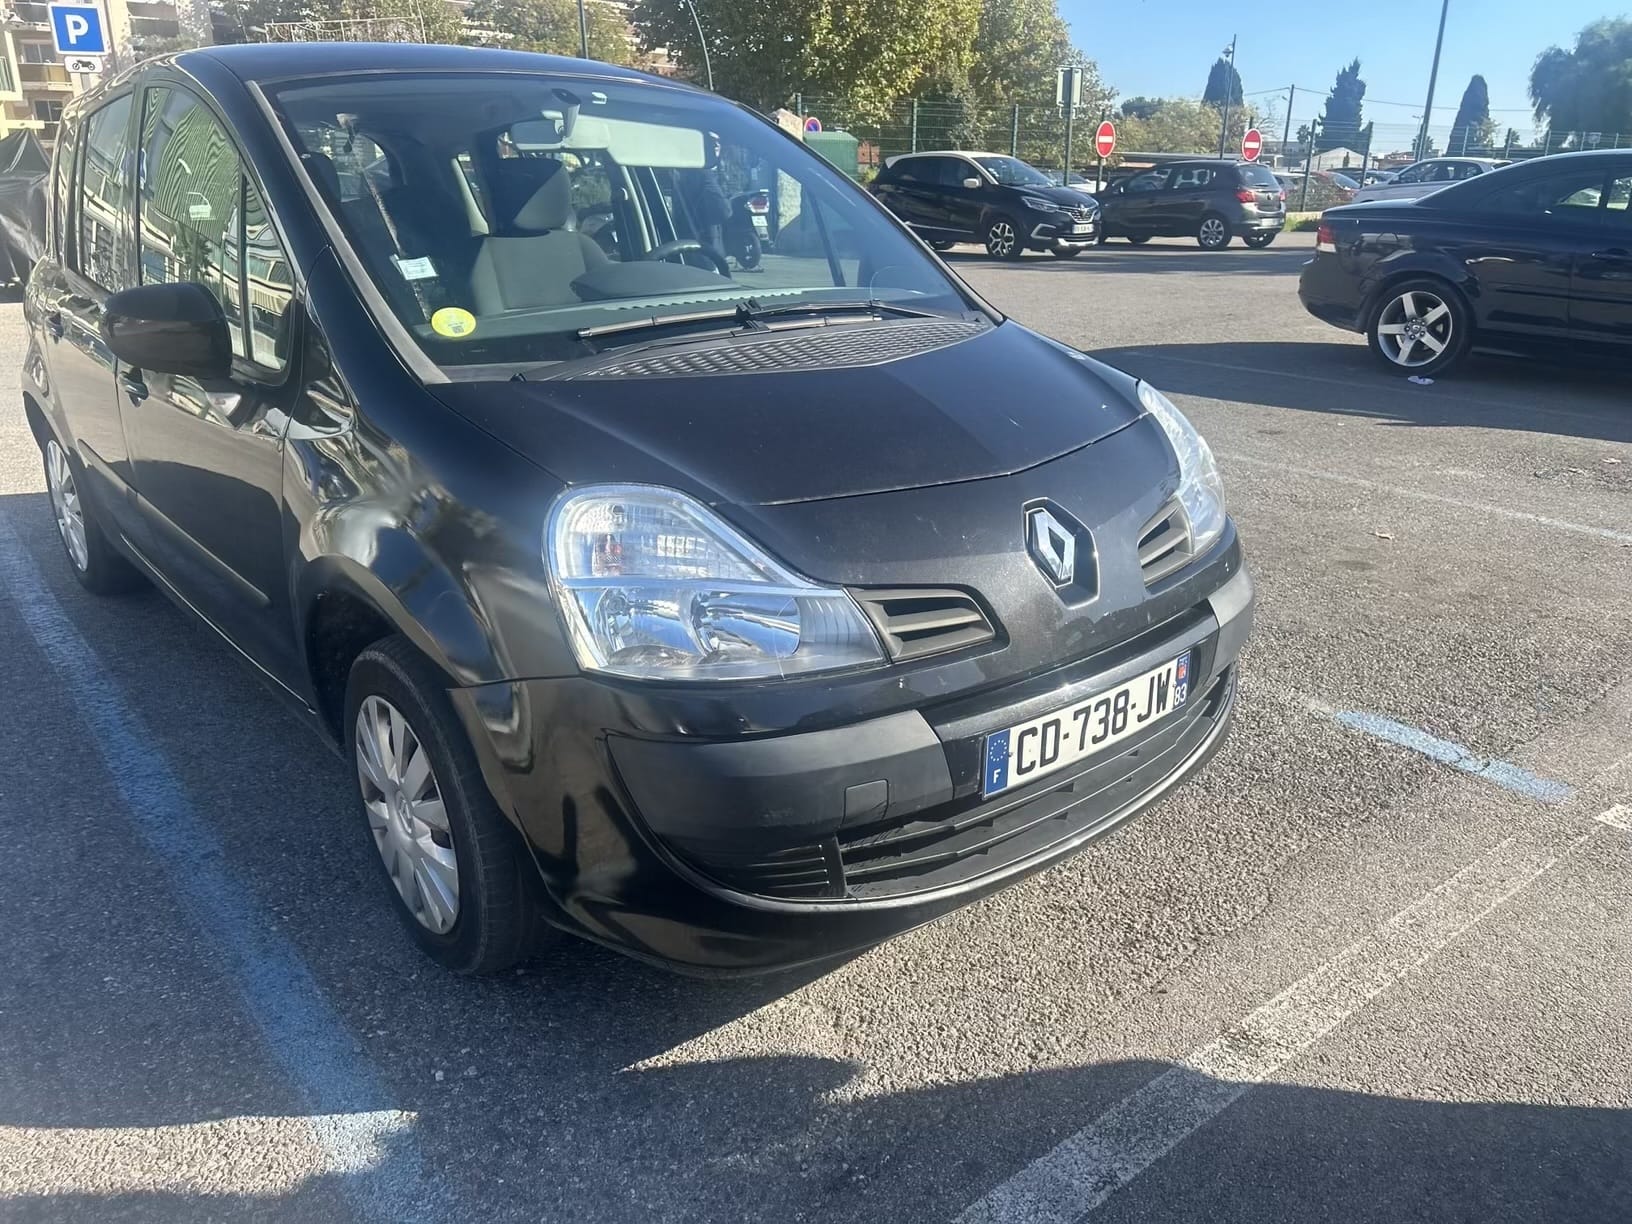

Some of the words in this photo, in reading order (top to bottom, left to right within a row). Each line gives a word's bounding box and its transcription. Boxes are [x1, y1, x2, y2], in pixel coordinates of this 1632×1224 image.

[65, 14, 89, 45] P
[1174, 683, 1187, 706] 83
[1016, 667, 1172, 776] CD-738-JW
[993, 768, 1002, 784] F
